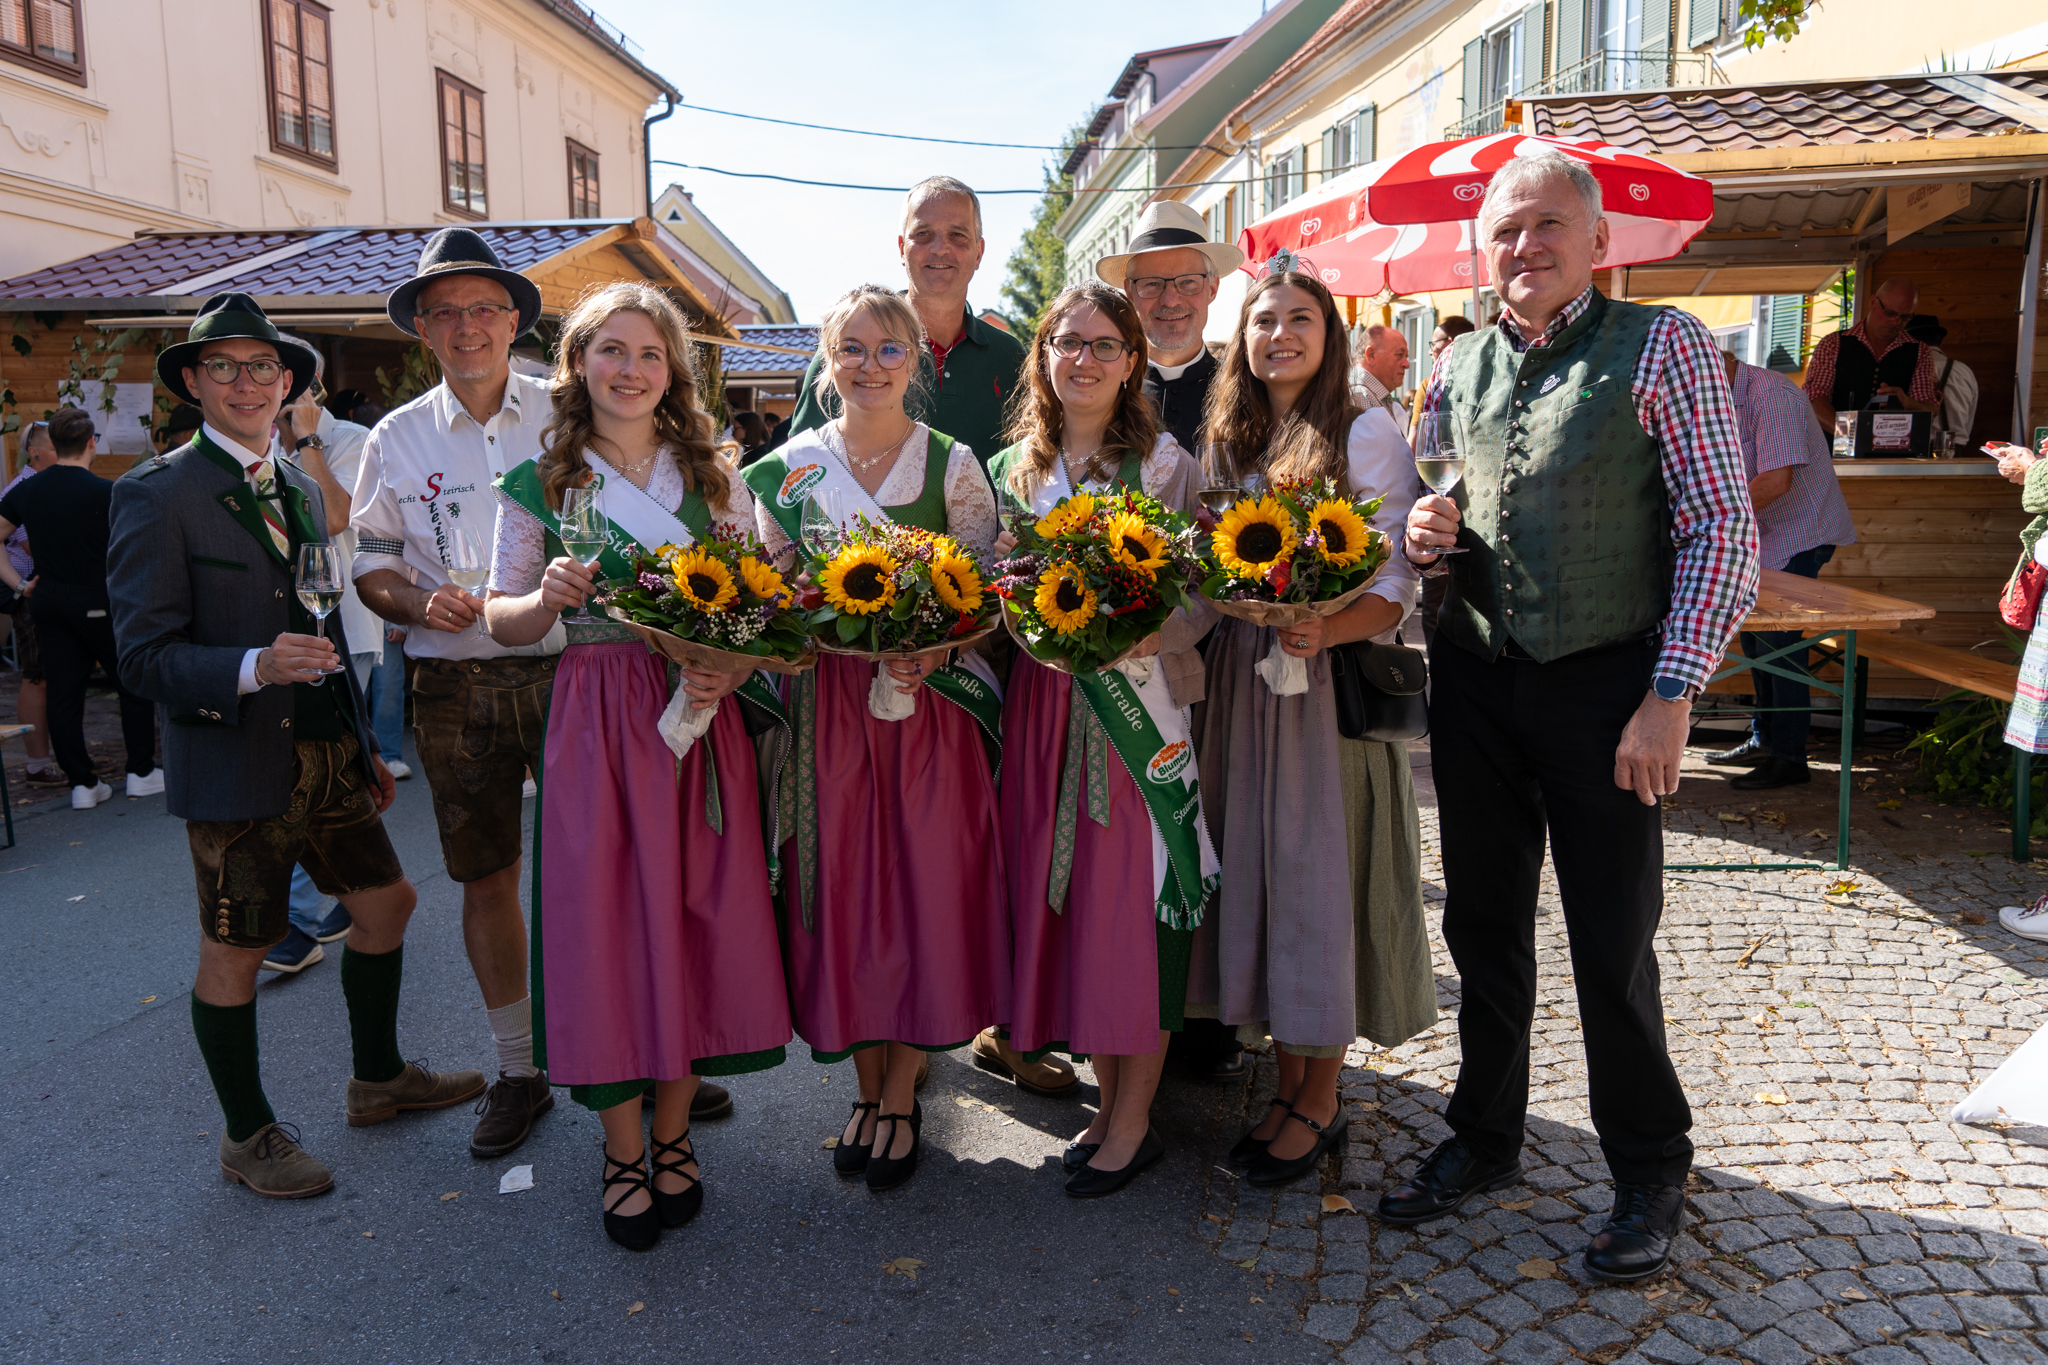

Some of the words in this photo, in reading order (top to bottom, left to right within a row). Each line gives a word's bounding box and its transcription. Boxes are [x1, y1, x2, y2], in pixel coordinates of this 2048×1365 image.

[398, 494, 416, 504] echt
[787, 470, 820, 501] Blumen
[1157, 750, 1188, 777] Blumen
